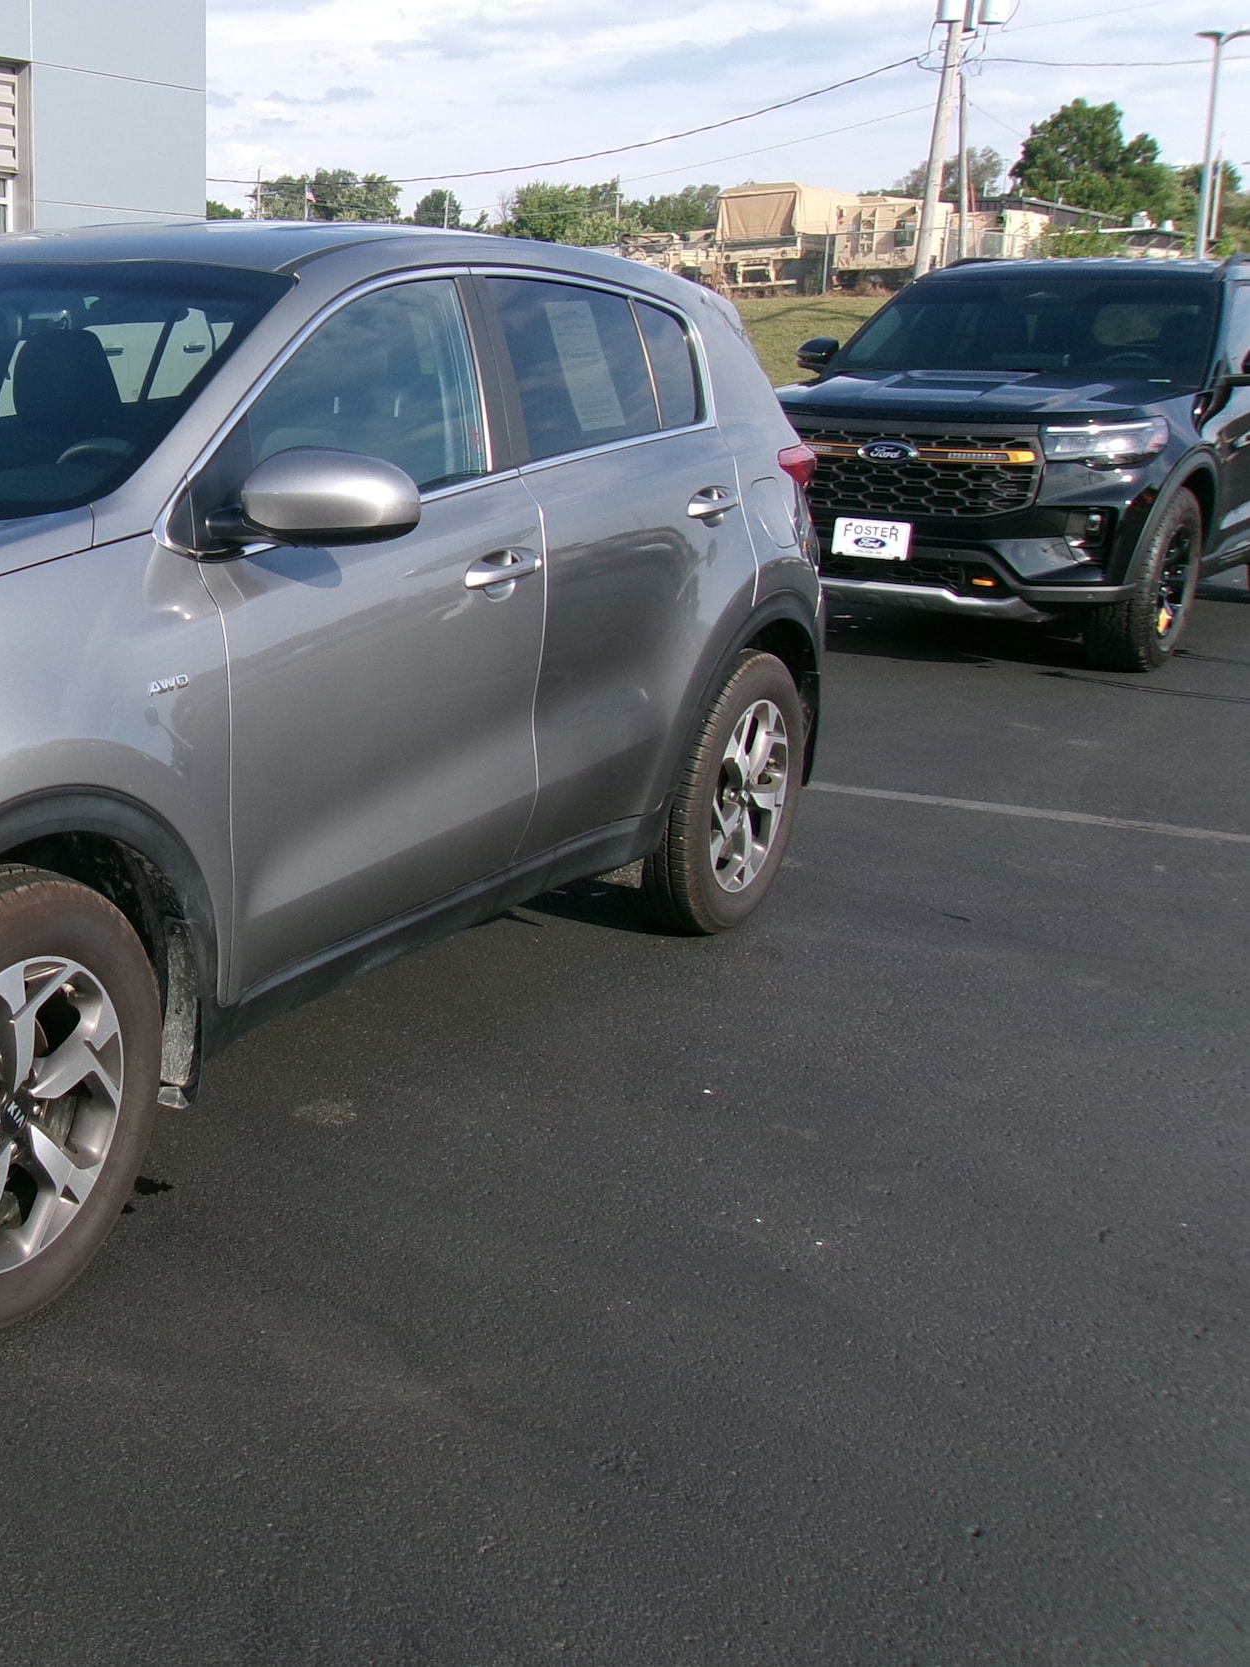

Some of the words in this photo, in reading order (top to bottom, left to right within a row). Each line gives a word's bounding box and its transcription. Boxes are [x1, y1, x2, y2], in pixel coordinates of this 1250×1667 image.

[869, 445, 901, 459] Ford
[843, 522, 899, 541] FOSTER
[857, 538, 882, 549] Ford
[148, 673, 189, 696] AWD
